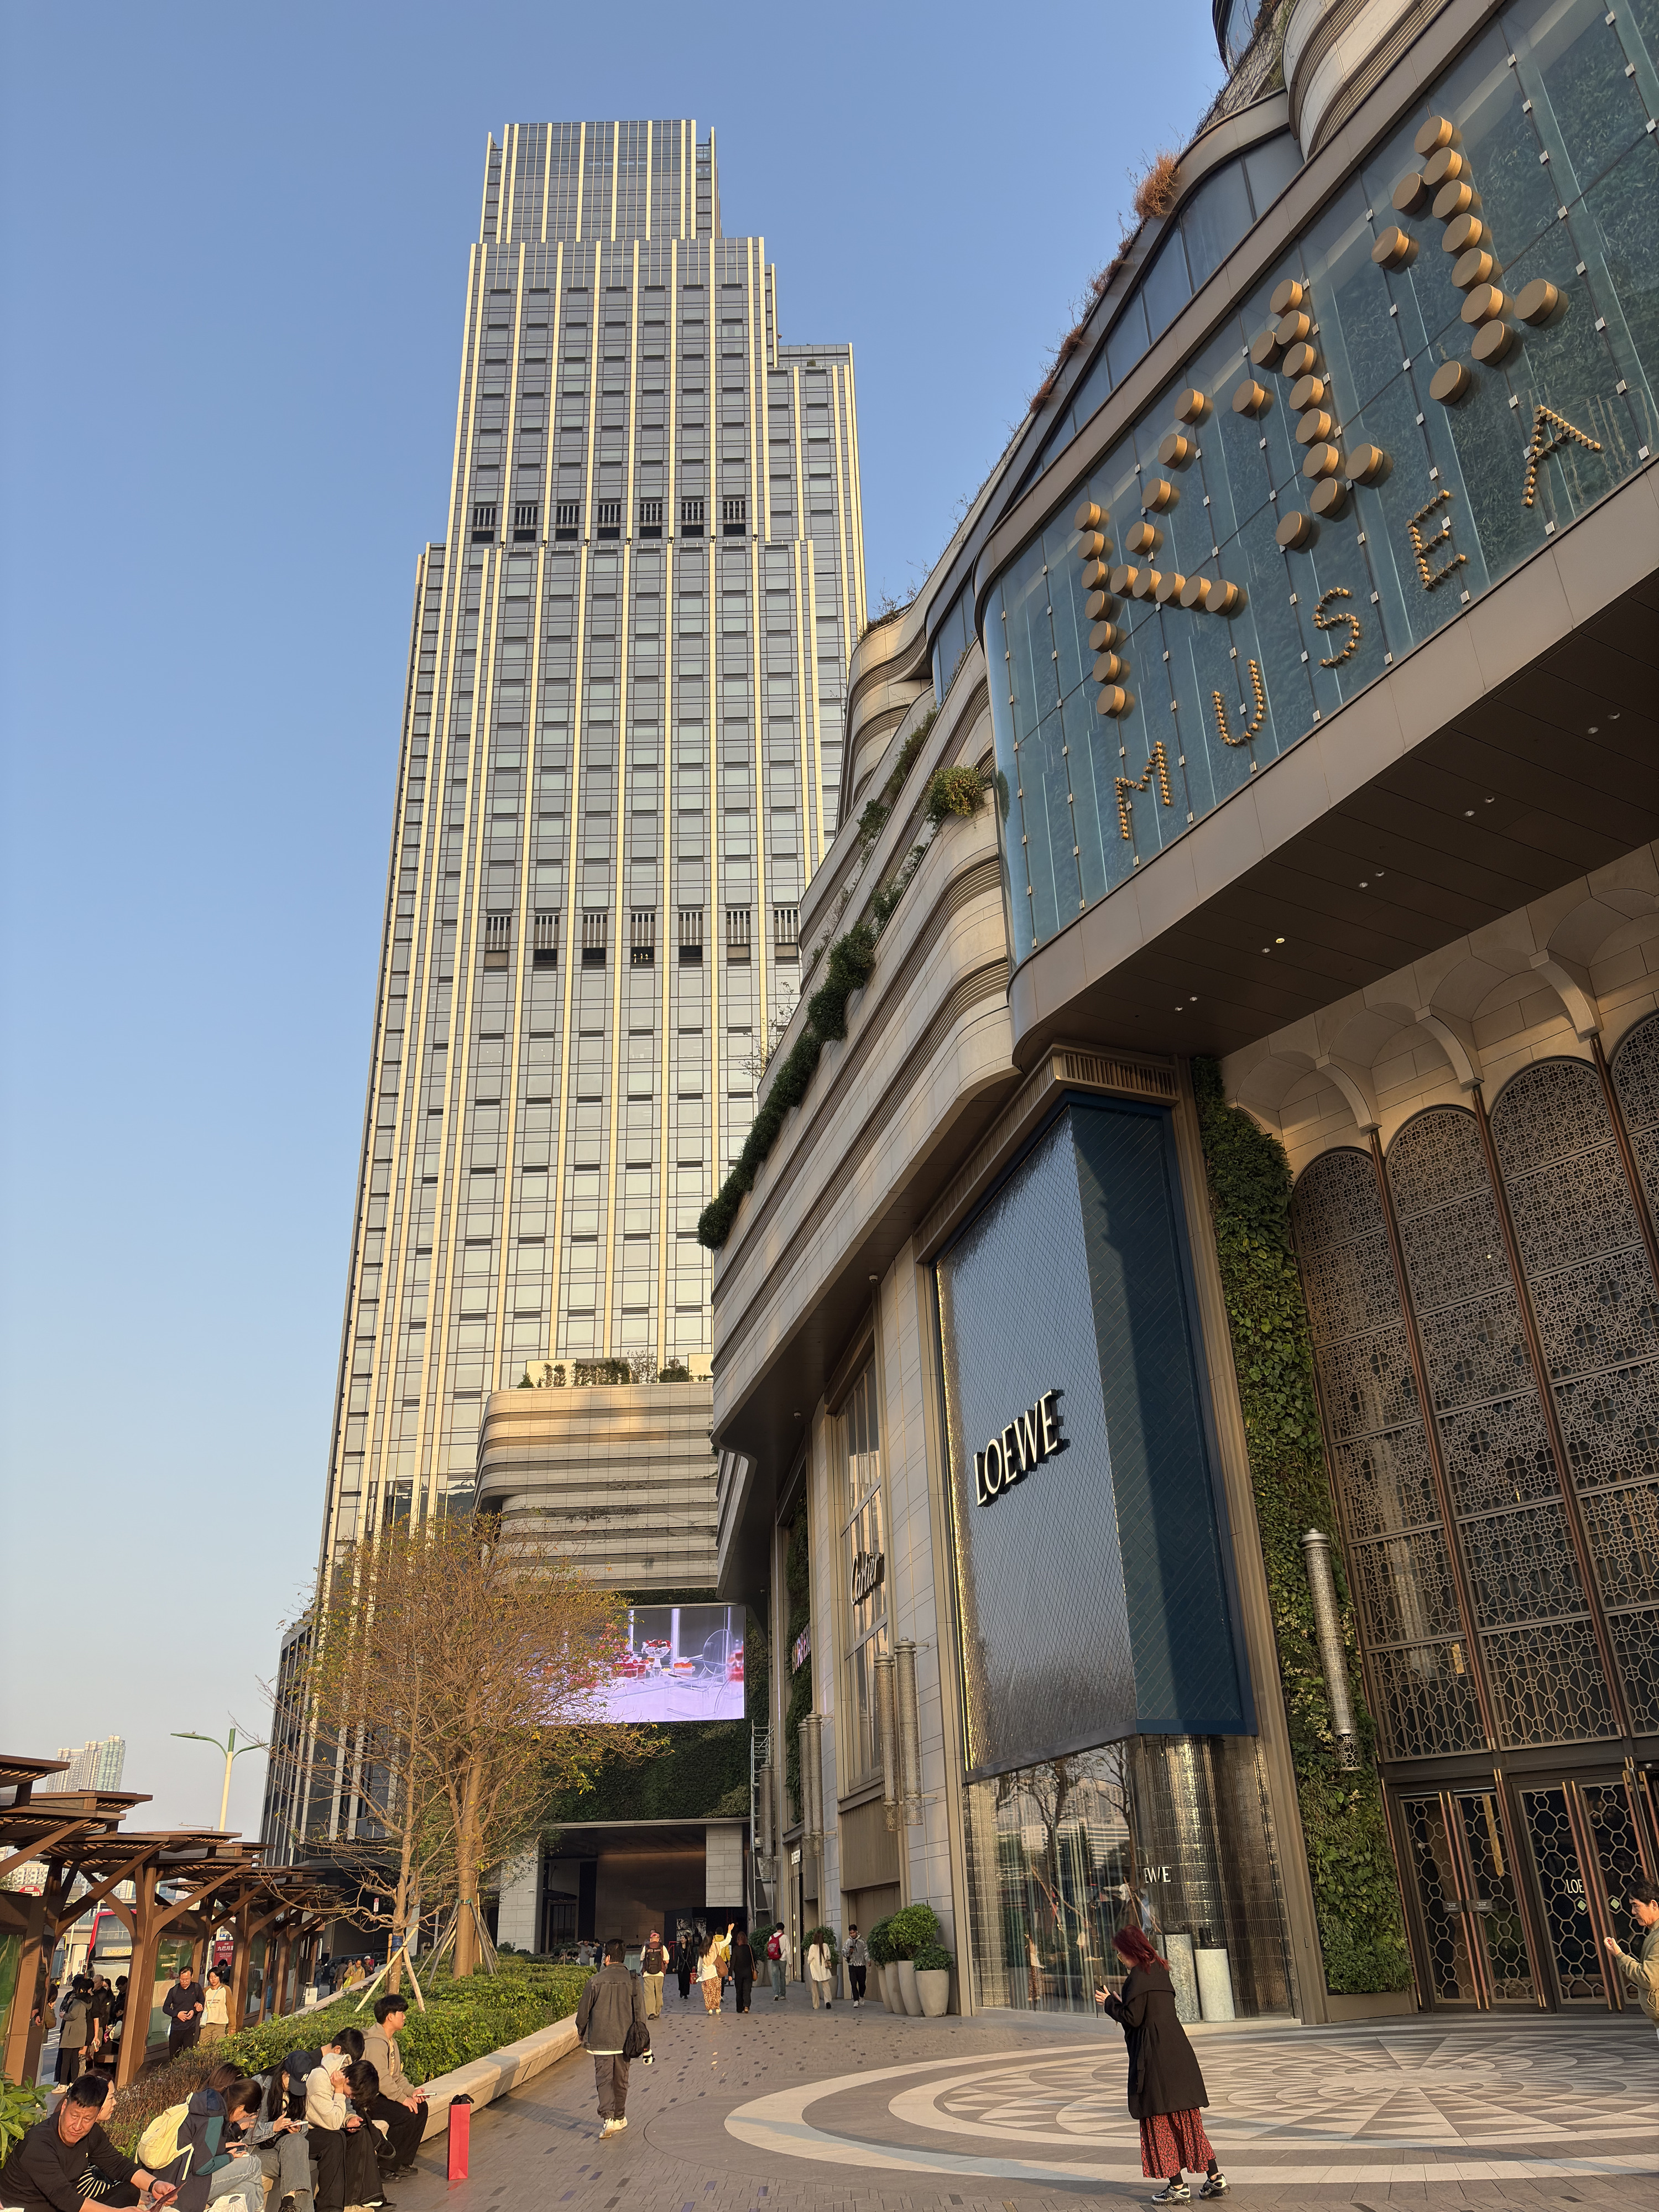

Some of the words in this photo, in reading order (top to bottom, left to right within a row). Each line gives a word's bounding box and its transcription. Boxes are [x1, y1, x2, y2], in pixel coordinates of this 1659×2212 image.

[1074, 115, 1562, 719] K11
[1114, 404, 1601, 841] MUSEA
[973, 1389, 1064, 1507] LOEWE
[851, 1552, 883, 1605] Cartier
[1144, 1866, 1172, 1883] EWE
[1566, 1879, 1584, 1893] LOE
